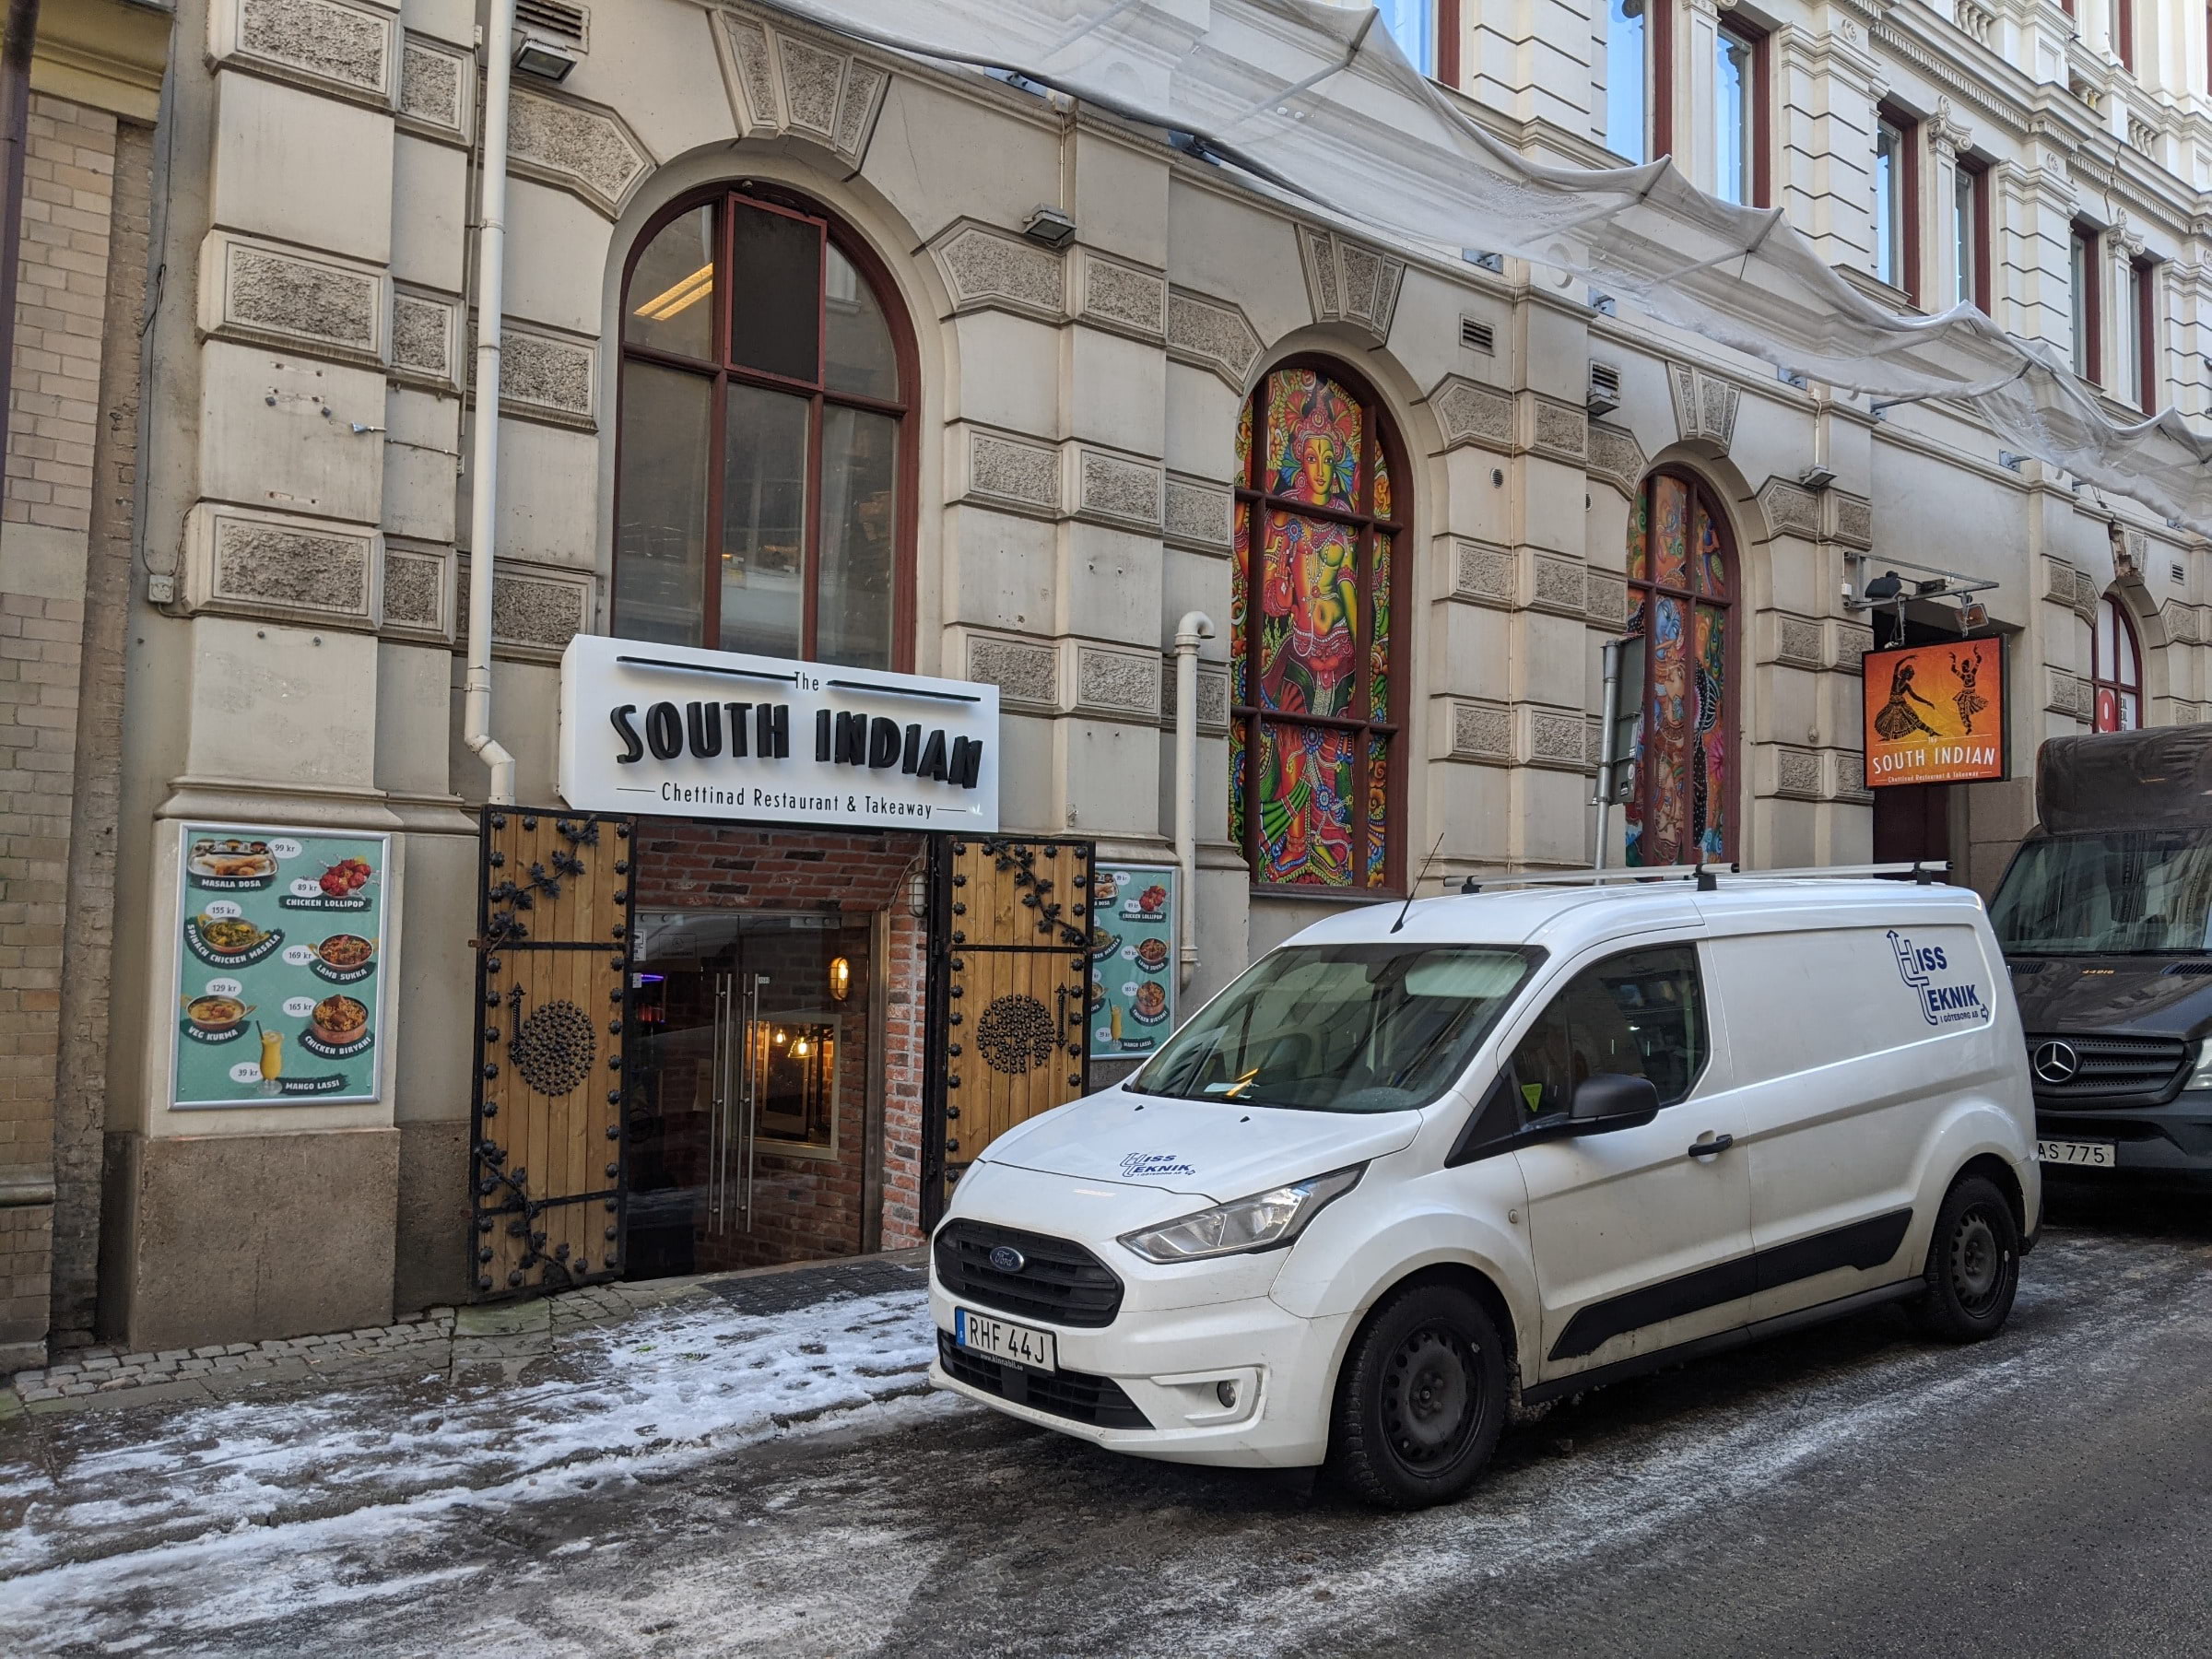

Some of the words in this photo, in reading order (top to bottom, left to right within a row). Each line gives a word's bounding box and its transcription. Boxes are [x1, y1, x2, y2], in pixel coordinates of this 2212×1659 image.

[794, 671, 819, 691] The
[610, 701, 790, 764] SOUTH
[816, 709, 982, 789] INDIAN
[1873, 748, 1925, 774] SOUTH
[1935, 746, 1994, 765] INDIAN
[1915, 772, 1945, 781] Restaurant
[662, 782, 745, 806] Chettinad
[754, 788, 838, 812] Restaurant
[847, 795, 856, 812] &
[865, 795, 932, 819] Takeaway
[275, 843, 285, 852] 99
[202, 879, 235, 888] MASALA
[212, 906, 225, 914] 155
[227, 906, 236, 914] kr
[286, 899, 322, 907] CHICKEN
[324, 900, 364, 908] LOLLIPOP
[187, 924, 210, 957] SPINACH
[210, 954, 247, 964] CHICKEN
[249, 934, 280, 959] MASALA
[288, 951, 301, 959] 169
[303, 951, 312, 959] kr
[1888, 932, 1947, 975] HISS
[316, 964, 337, 980] LAMB
[339, 968, 368, 981] SUKKA
[228, 984, 237, 993] kr
[288, 1003, 301, 1011] 165
[303, 1003, 312, 1011] kr
[1911, 977, 1981, 1024] TEKNIK
[1943, 1012, 1971, 1023] GÖTEBORG
[1971, 1010, 1979, 1018] AB
[188, 1026, 205, 1039] VEG
[206, 1029, 238, 1041] KURMA
[305, 1035, 336, 1054] CHICKEN
[338, 1036, 371, 1054] BIRYANI
[285, 1082, 314, 1090] MANGO
[317, 1079, 340, 1089] LASSI
[1123, 1153, 1177, 1164] HISS
[2038, 1143, 2059, 1159] AS
[2066, 1145, 2105, 1163] 775
[1124, 1163, 1194, 1177] TEKNIK
[995, 1250, 1015, 1267] Ford
[970, 1317, 1001, 1351] RHF
[1008, 1329, 1044, 1364] 44J
